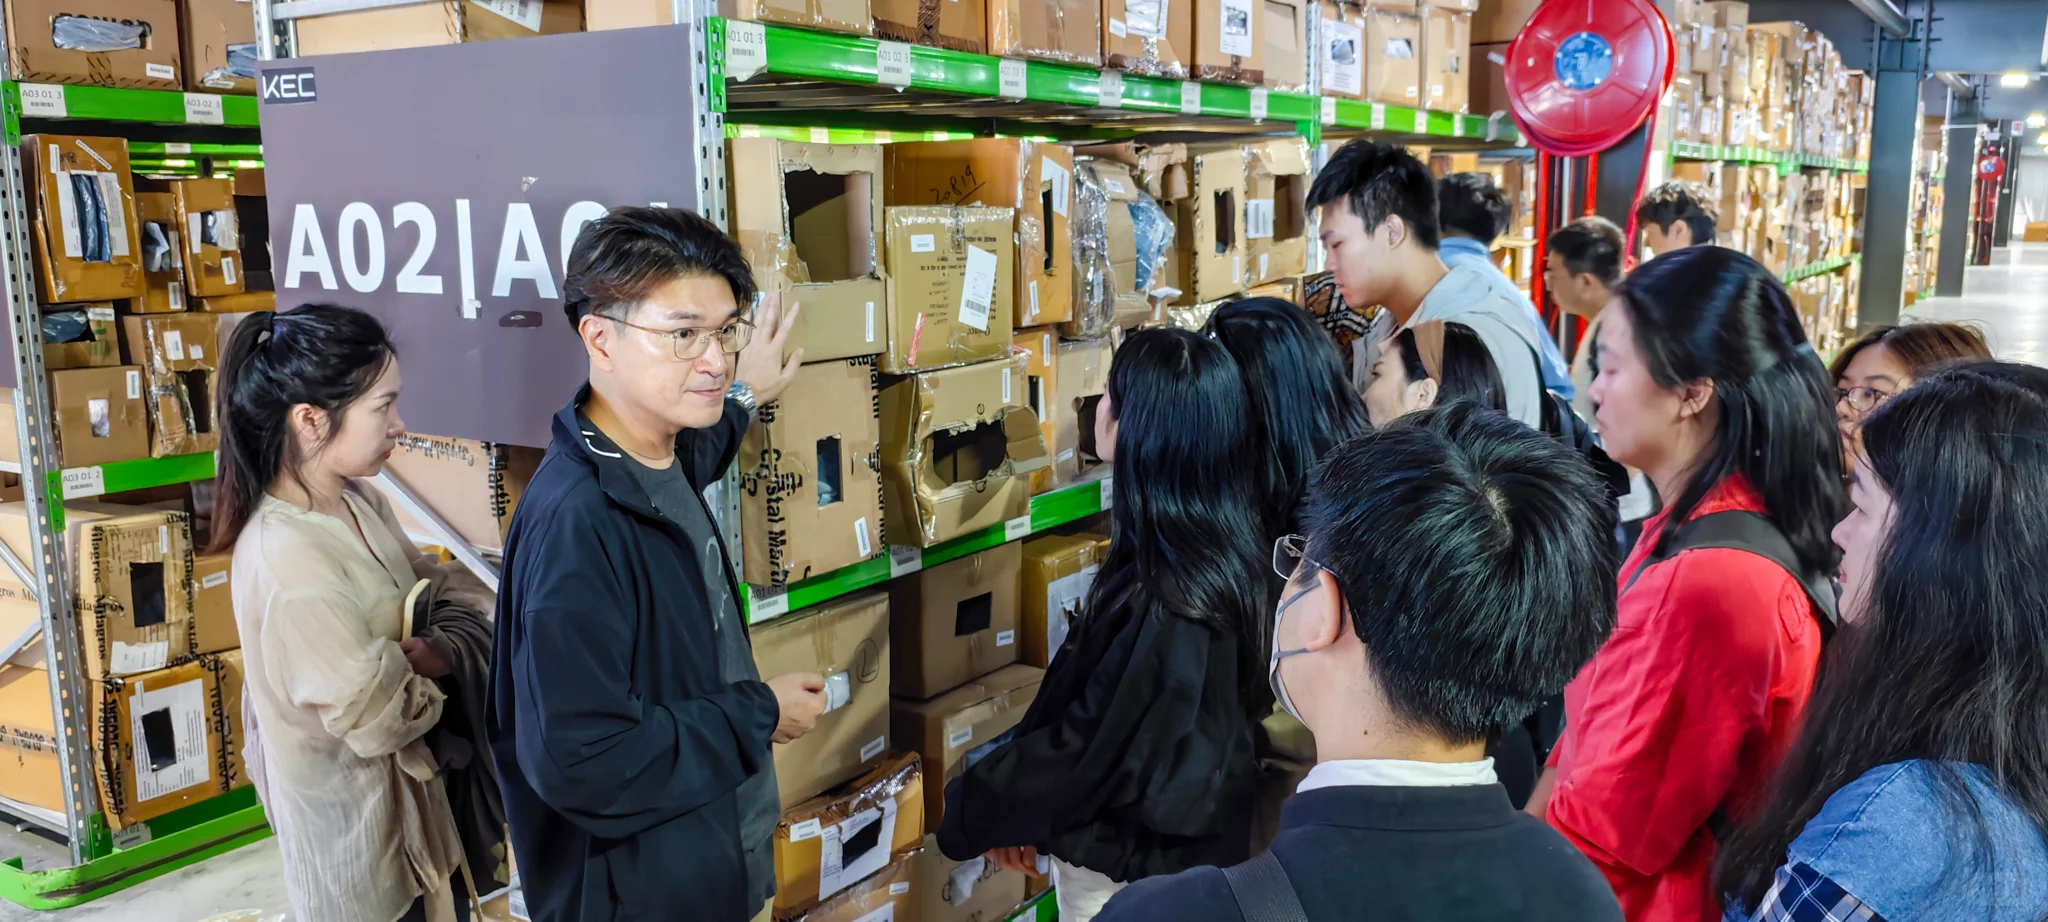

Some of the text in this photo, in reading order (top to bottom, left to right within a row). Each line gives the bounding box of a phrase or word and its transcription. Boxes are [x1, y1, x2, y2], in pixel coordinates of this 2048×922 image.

[743, 31, 754, 43] 01
[878, 52, 892, 62] A01
[262, 73, 316, 99] KEC
[22, 89, 40, 98] A03
[42, 90, 53, 99] 01
[186, 98, 201, 107] A03
[202, 100, 212, 108] 02
[63, 474, 79, 482] A03
[80, 471, 92, 480] 01
